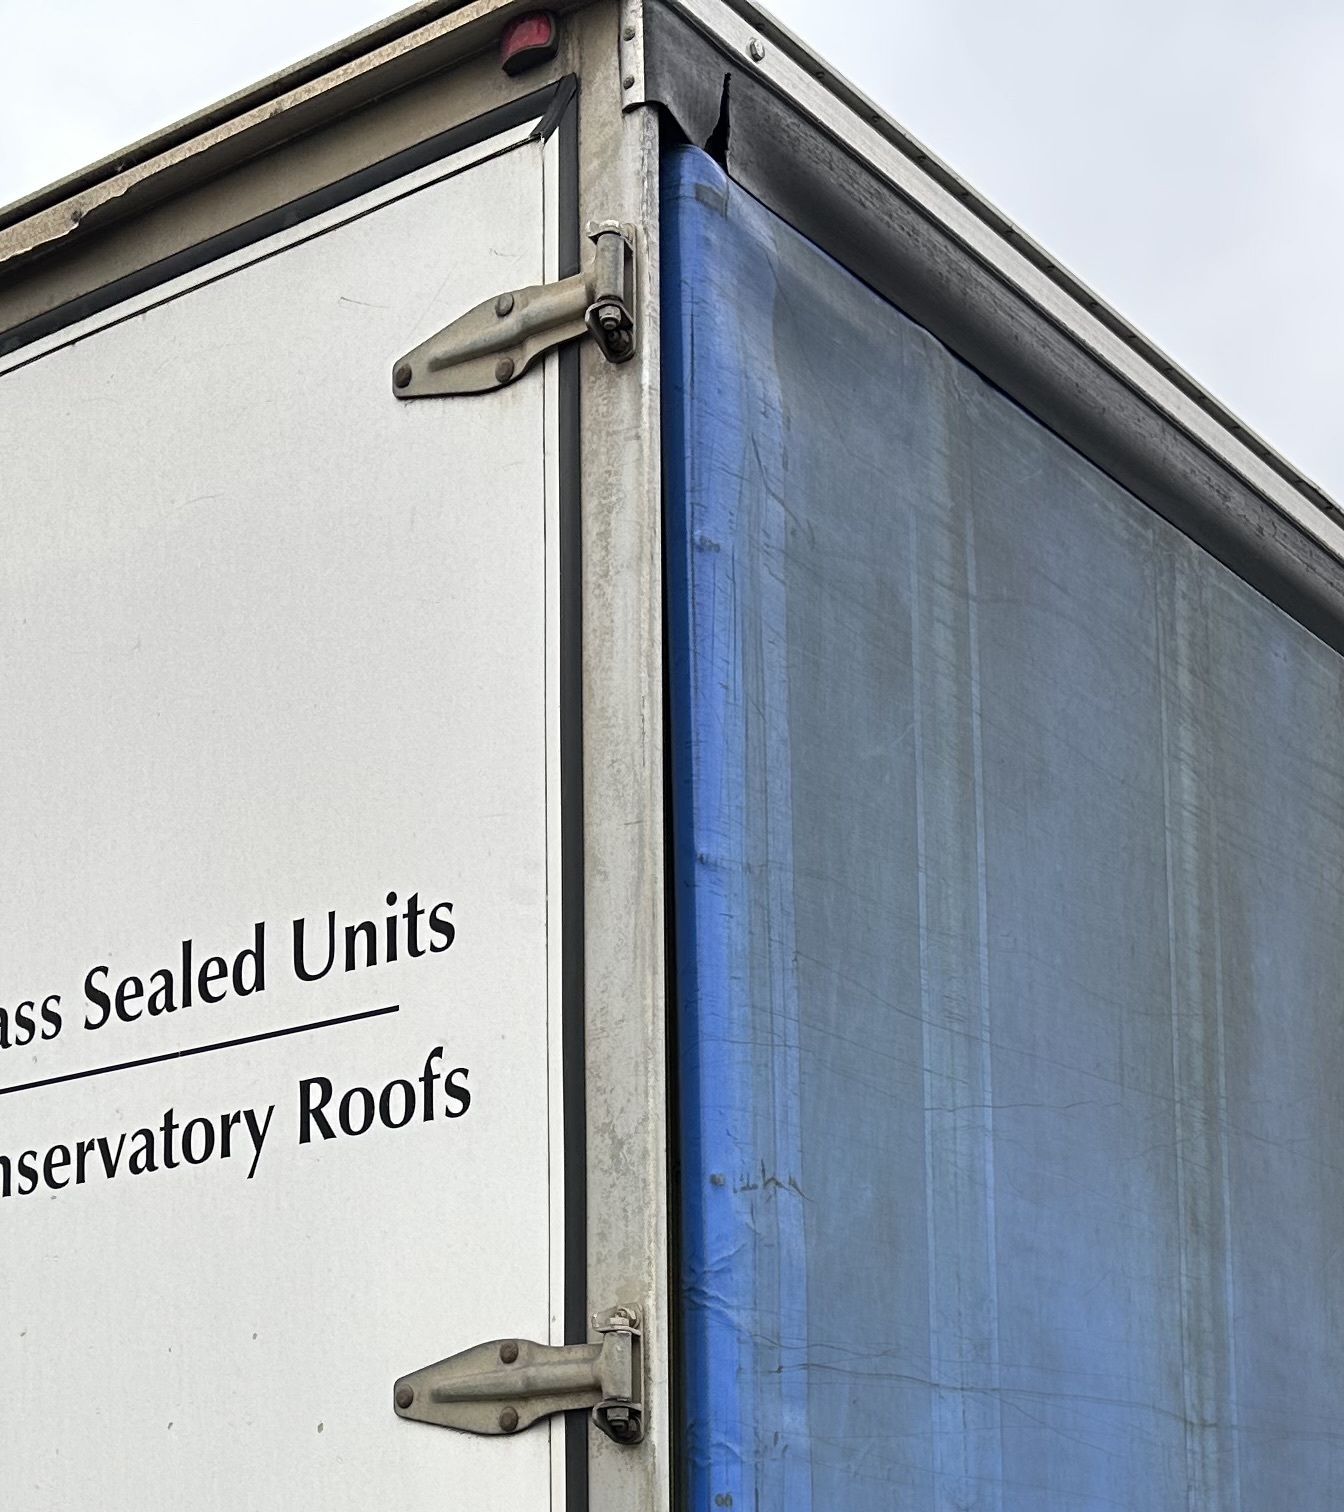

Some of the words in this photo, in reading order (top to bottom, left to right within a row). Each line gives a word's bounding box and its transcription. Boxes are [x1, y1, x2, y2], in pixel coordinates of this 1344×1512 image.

[83, 922, 266, 1030] Sealed
[292, 891, 456, 981] Units
[298, 1046, 471, 1145] Roofs
